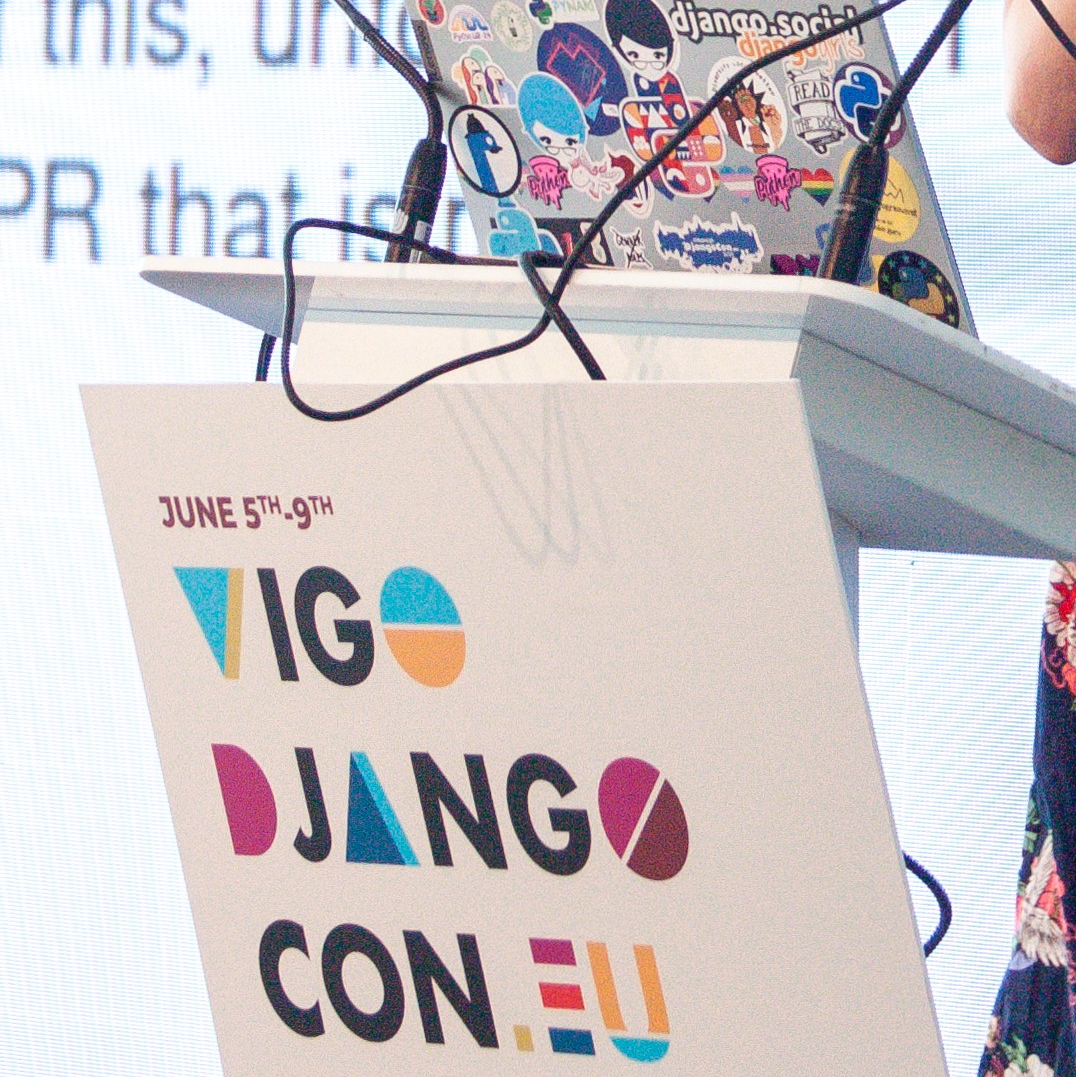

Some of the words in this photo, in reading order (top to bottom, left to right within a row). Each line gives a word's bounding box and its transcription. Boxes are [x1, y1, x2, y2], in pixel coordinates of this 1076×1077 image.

[793, 81, 830, 101] READ
[0, 157, 101, 262] PR
[139, 161, 310, 259] that
[158, 495, 238, 529] JUNE
[242, 495, 335, 530] 5TH-9TH
[172, 565, 467, 689] VIGO
[210, 742, 690, 882] DJANGO
